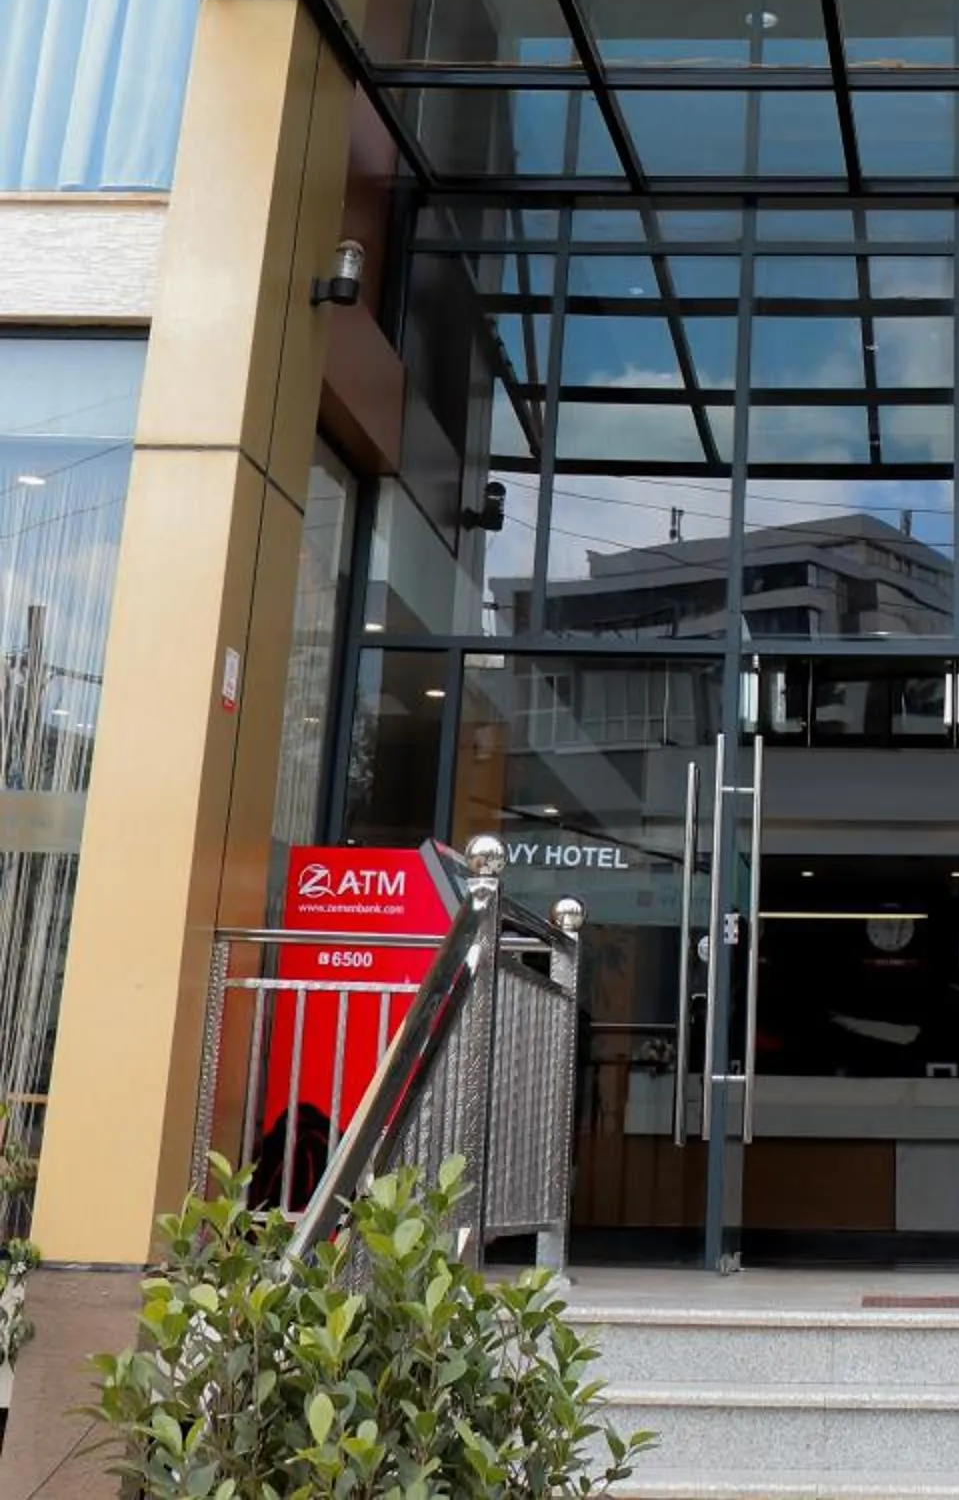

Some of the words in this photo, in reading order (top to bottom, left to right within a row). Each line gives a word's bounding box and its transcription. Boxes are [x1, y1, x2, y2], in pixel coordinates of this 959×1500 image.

[545, 845, 629, 869] HOTEL
[337, 869, 406, 896] ATM
[332, 952, 373, 968] 6500
